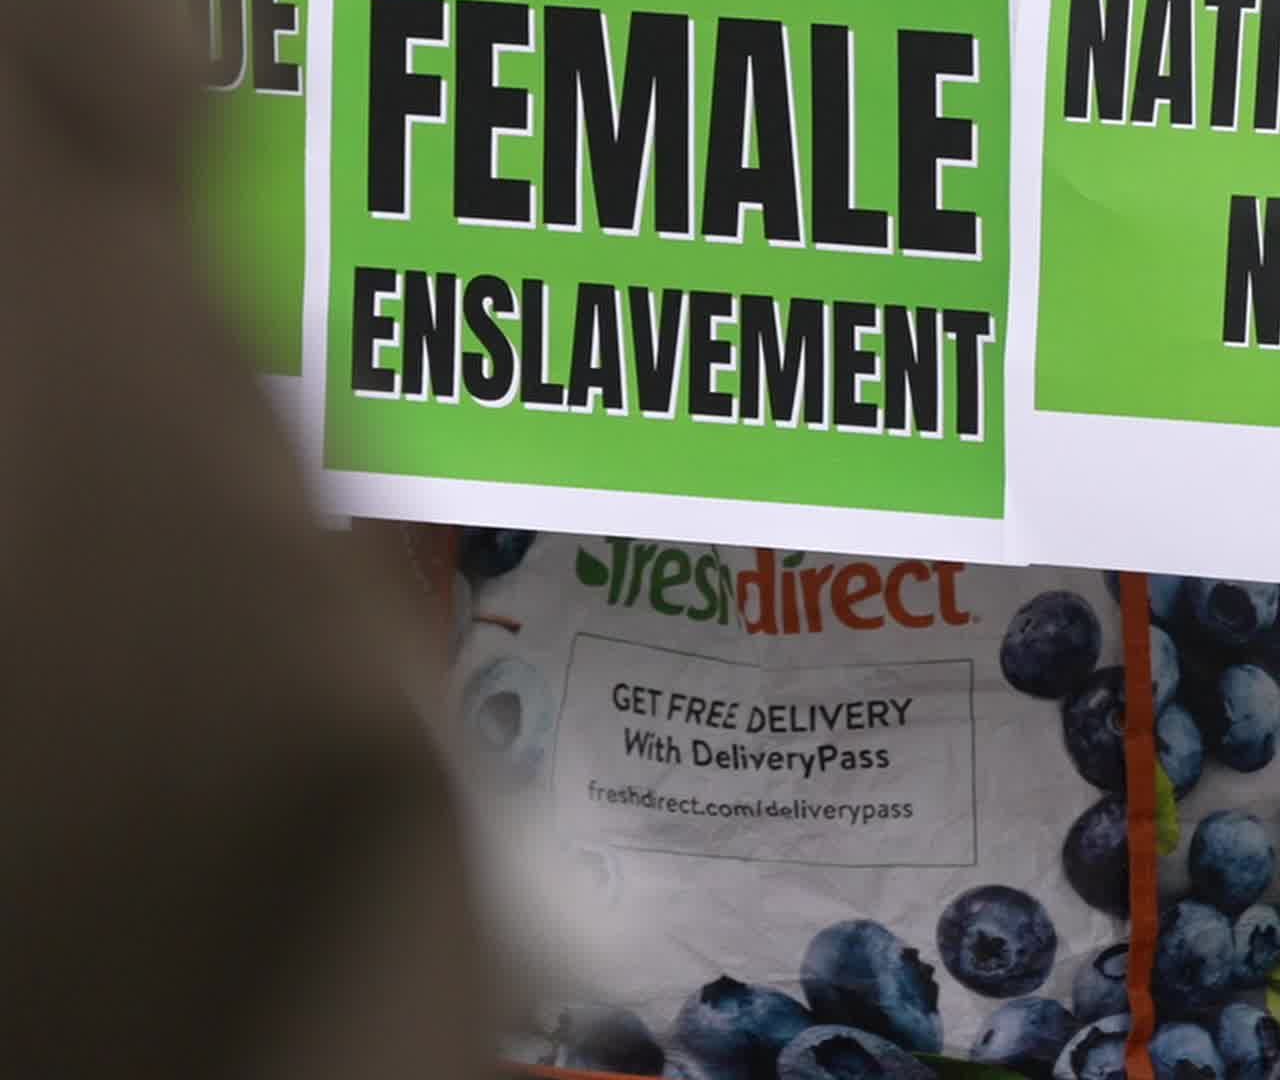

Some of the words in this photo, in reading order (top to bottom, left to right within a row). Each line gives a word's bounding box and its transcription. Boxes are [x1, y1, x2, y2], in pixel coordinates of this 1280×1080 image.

[350, 265, 994, 442] ENSLAVEMENT
[612, 682, 662, 717] GET
[667, 692, 739, 730] FREE
[746, 697, 913, 734] DELIVERY
[624, 727, 681, 765] With
[692, 739, 890, 779] DeliveryPass
